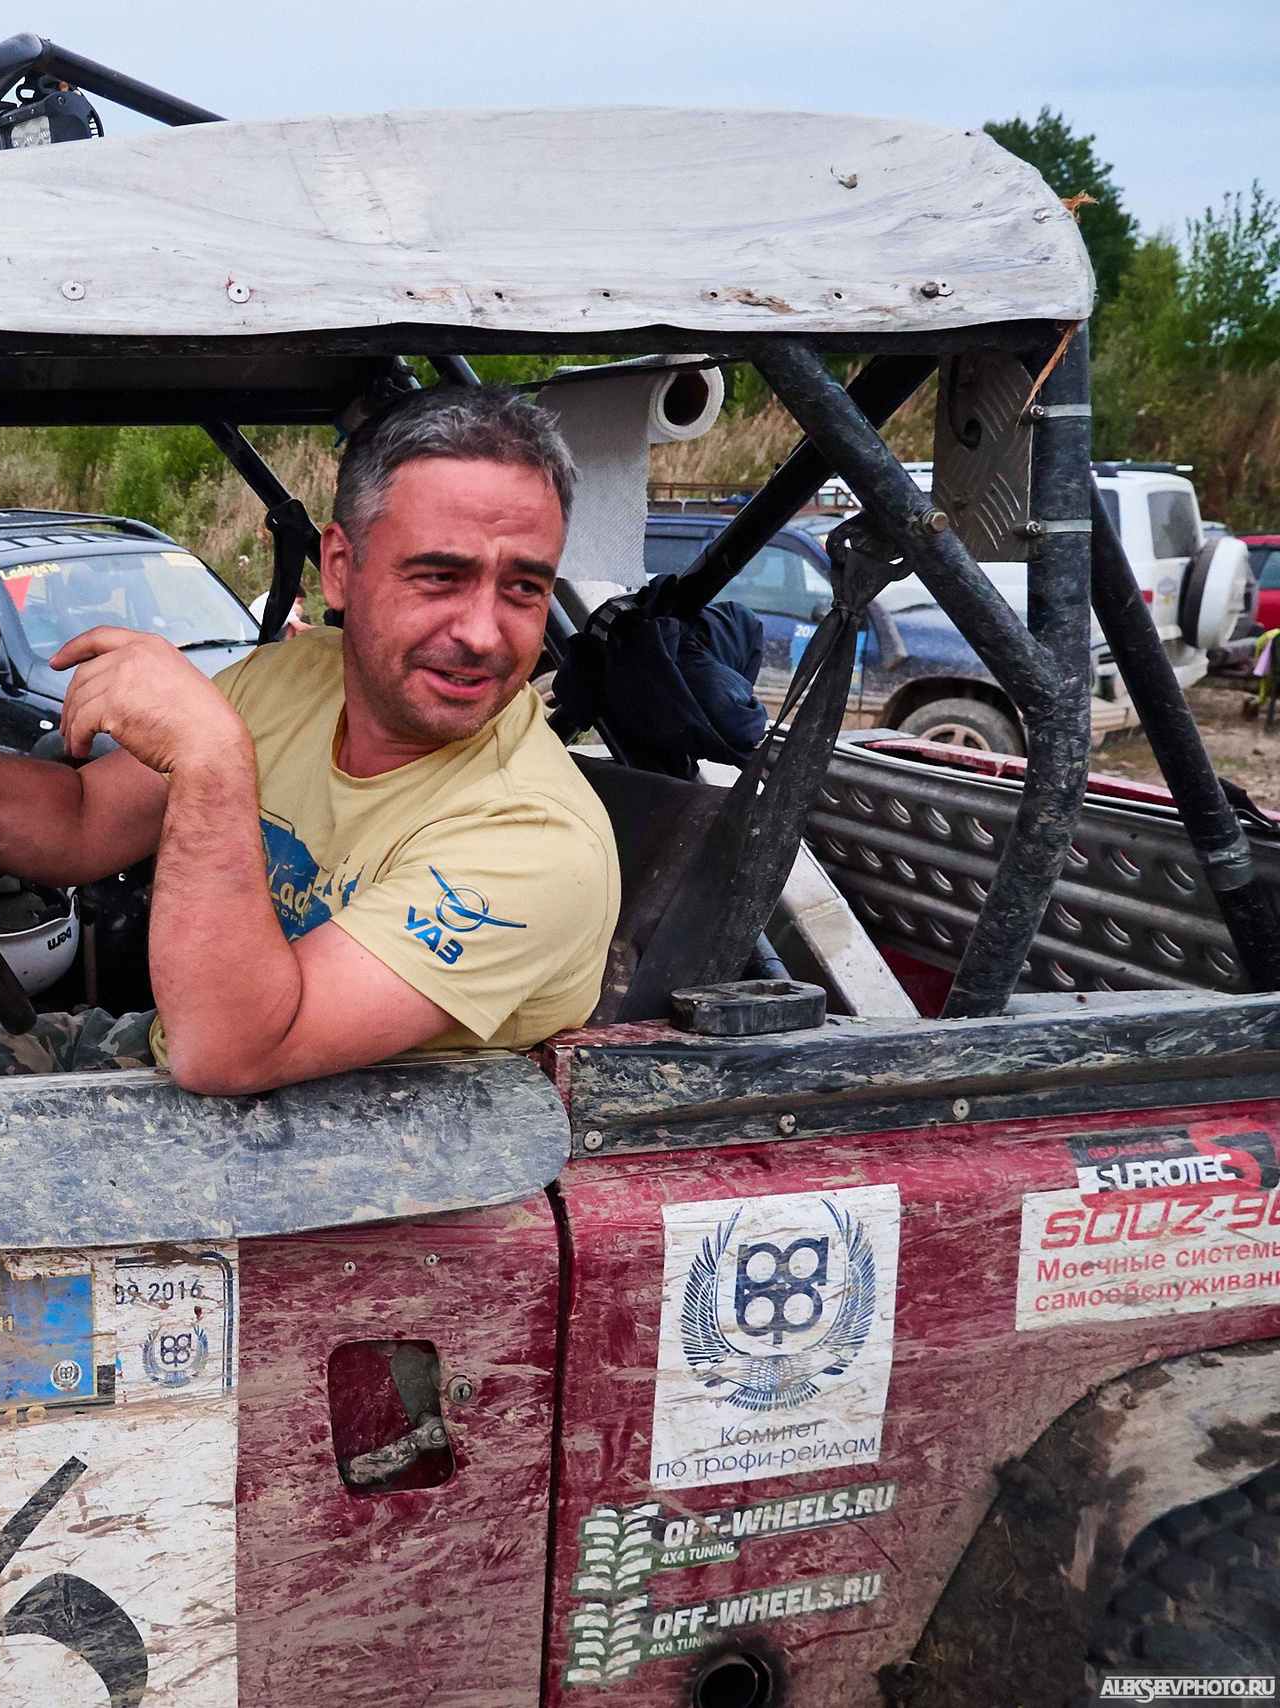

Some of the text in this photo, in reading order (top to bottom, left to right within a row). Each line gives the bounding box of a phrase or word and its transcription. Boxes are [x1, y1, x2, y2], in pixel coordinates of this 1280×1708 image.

[404, 905, 464, 965] УАЗ
[1096, 1153, 1238, 1192] SUPROTEC
[1036, 1251, 1166, 1282] Моечные
[720, 1421, 822, 1447] Комитет
[656, 1434, 876, 1479] по трофи-рейдам
[663, 1485, 896, 1549] OFF-WHEELS.RU
[688, 1542, 735, 1561] TUNING
[652, 1574, 882, 1640] OFF-WHEELS.RU
